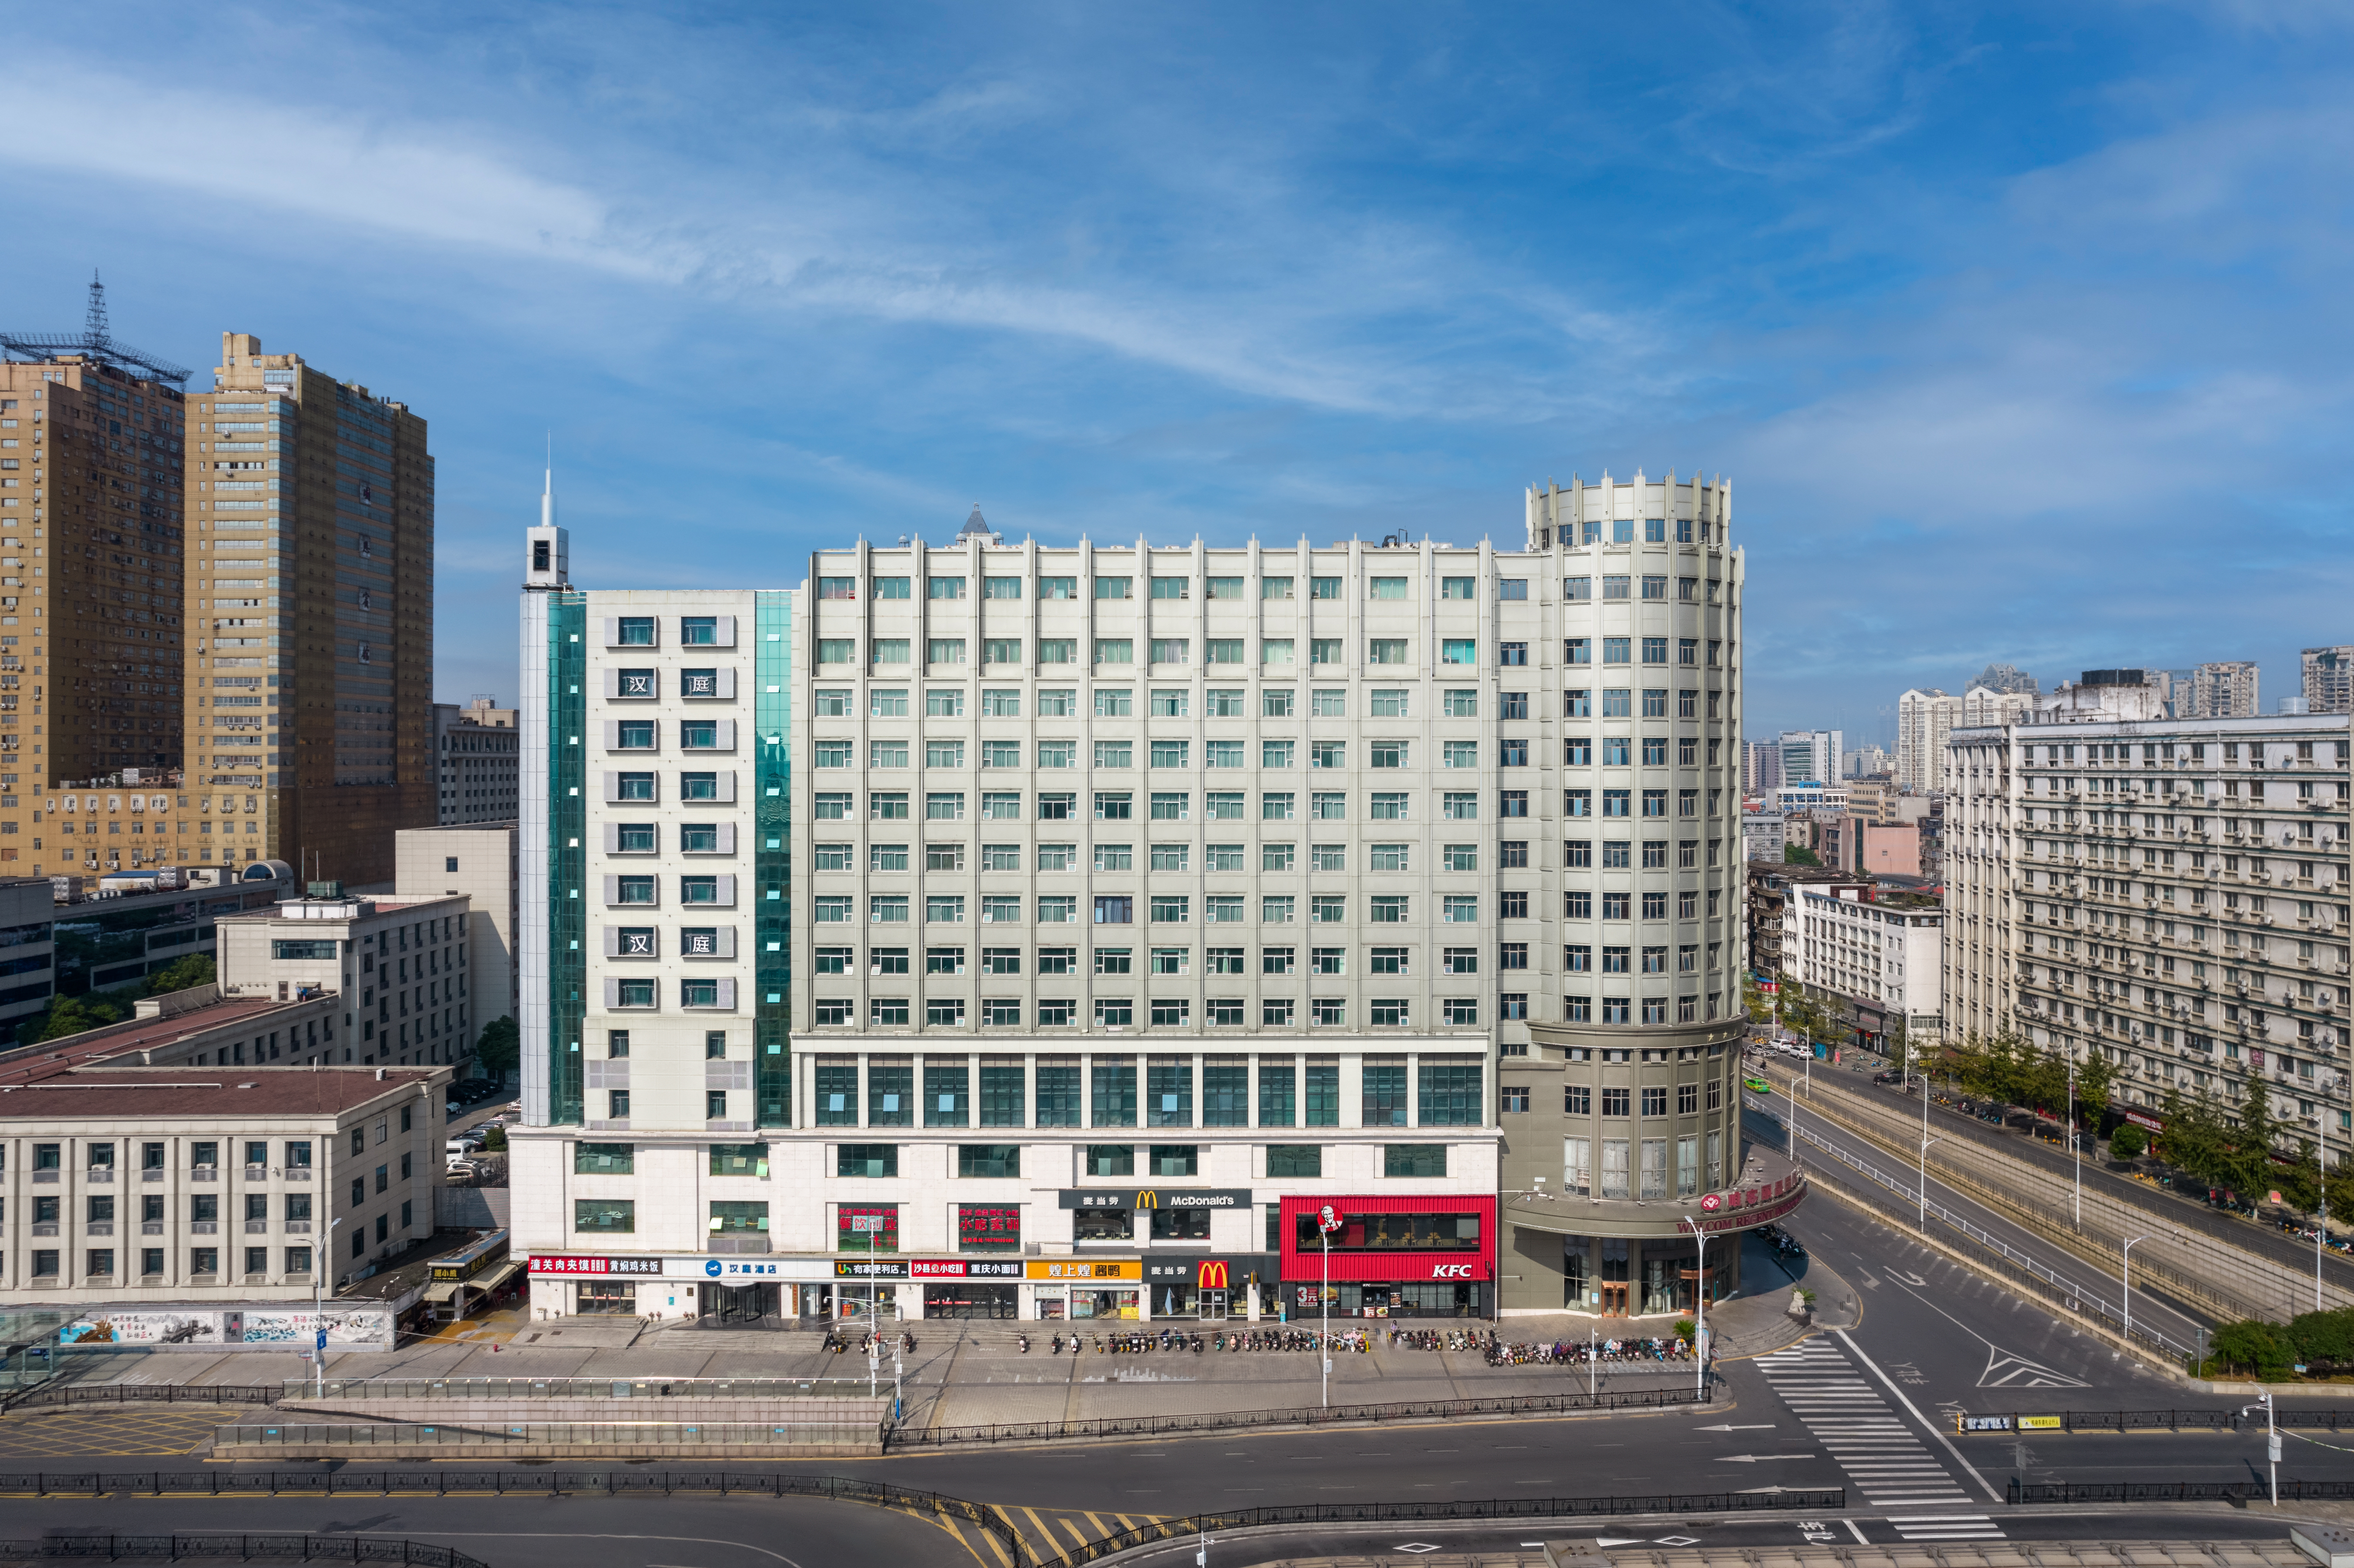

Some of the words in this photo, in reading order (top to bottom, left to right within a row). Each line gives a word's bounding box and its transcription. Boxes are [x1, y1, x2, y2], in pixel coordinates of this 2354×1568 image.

[629, 676, 709, 693] 汉庭
[630, 935, 709, 953] 汉庭
[1083, 1196, 1119, 1206] 麦当劳
[1171, 1196, 1235, 1206] McDonald's
[959, 1217, 1019, 1230] 小吃实训
[1736, 1209, 1774, 1228] REGENT
[530, 1259, 589, 1272] 潼关肉夹馍
[610, 1260, 659, 1272] 黄焖鸡米饭
[729, 1264, 776, 1273] 汉庭酒店
[854, 1264, 899, 1274] 有家便利店
[971, 1264, 1011, 1274] 重庆小面
[1049, 1264, 1091, 1278] 煌上煌
[1151, 1266, 1187, 1275] 麦当劳
[1432, 1265, 1472, 1277] KFC
[1297, 1287, 1317, 1302] 3元
